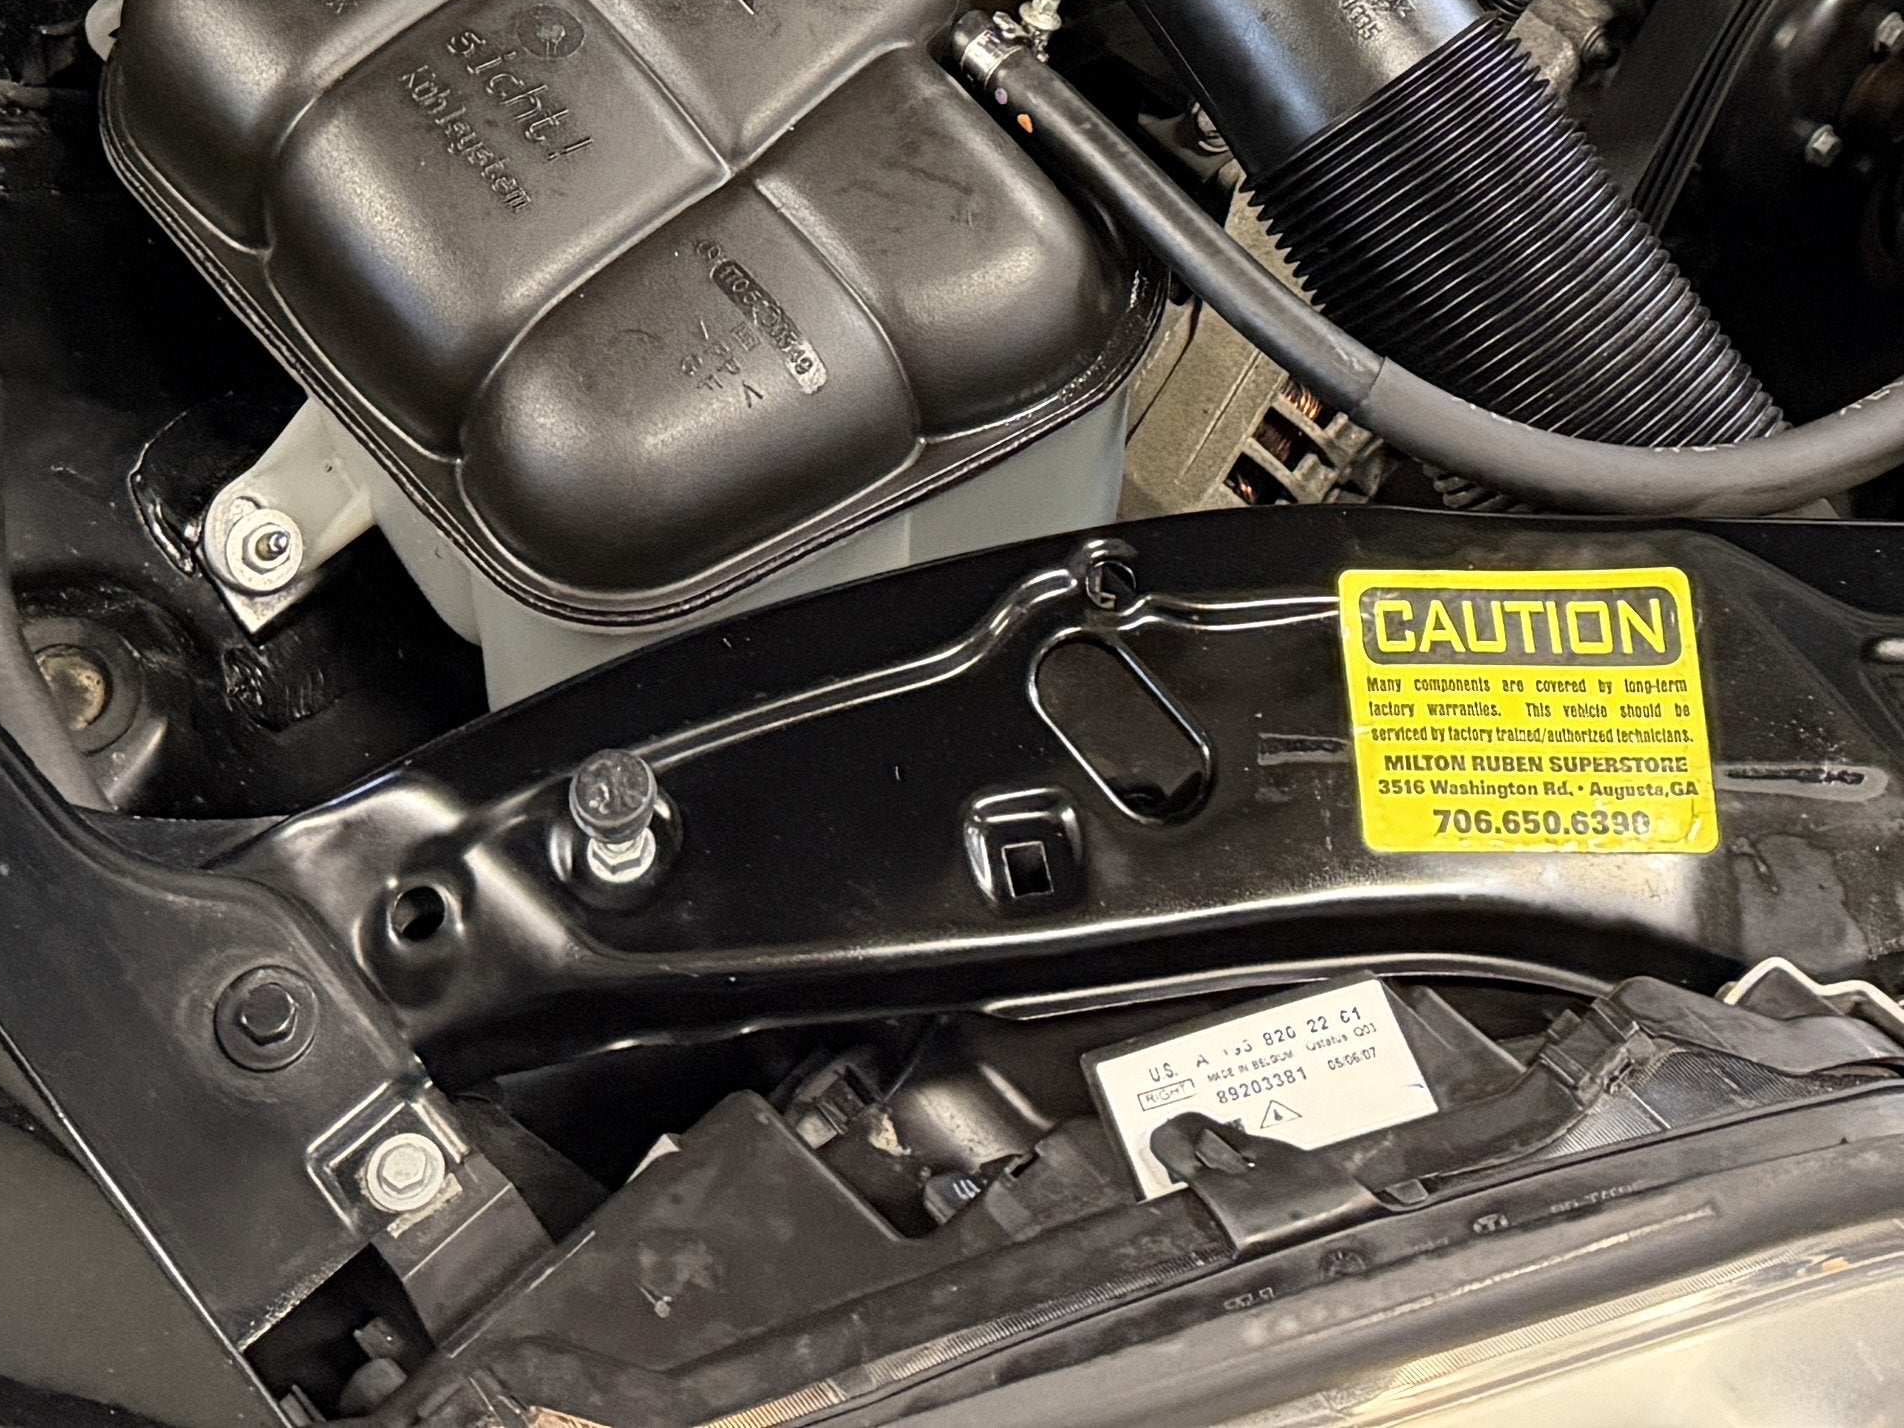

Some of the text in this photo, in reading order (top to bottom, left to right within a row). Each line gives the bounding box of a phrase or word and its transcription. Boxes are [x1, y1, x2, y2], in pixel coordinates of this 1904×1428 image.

[1374, 598, 1667, 654] CAUTION
[1366, 675, 1688, 695] Many components are covered by long-term
[1369, 701, 1690, 718] factory warranties. This vehicle should be
[1371, 726, 1427, 743] serviced
[1431, 727, 1446, 743] by
[1448, 727, 1493, 744] factory
[1616, 727, 1694, 744] technicians.
[1384, 755, 1688, 773] MILTON RUBEN SUPERSTORE
[1378, 780, 1425, 795] 3516
[1430, 780, 1538, 799] Washington
[1149, 1063, 1179, 1083] U.S.
[1307, 1016, 1329, 1034] 22
[1207, 1068, 1235, 1083] MADE
[1216, 1066, 1308, 1105] 89203381
